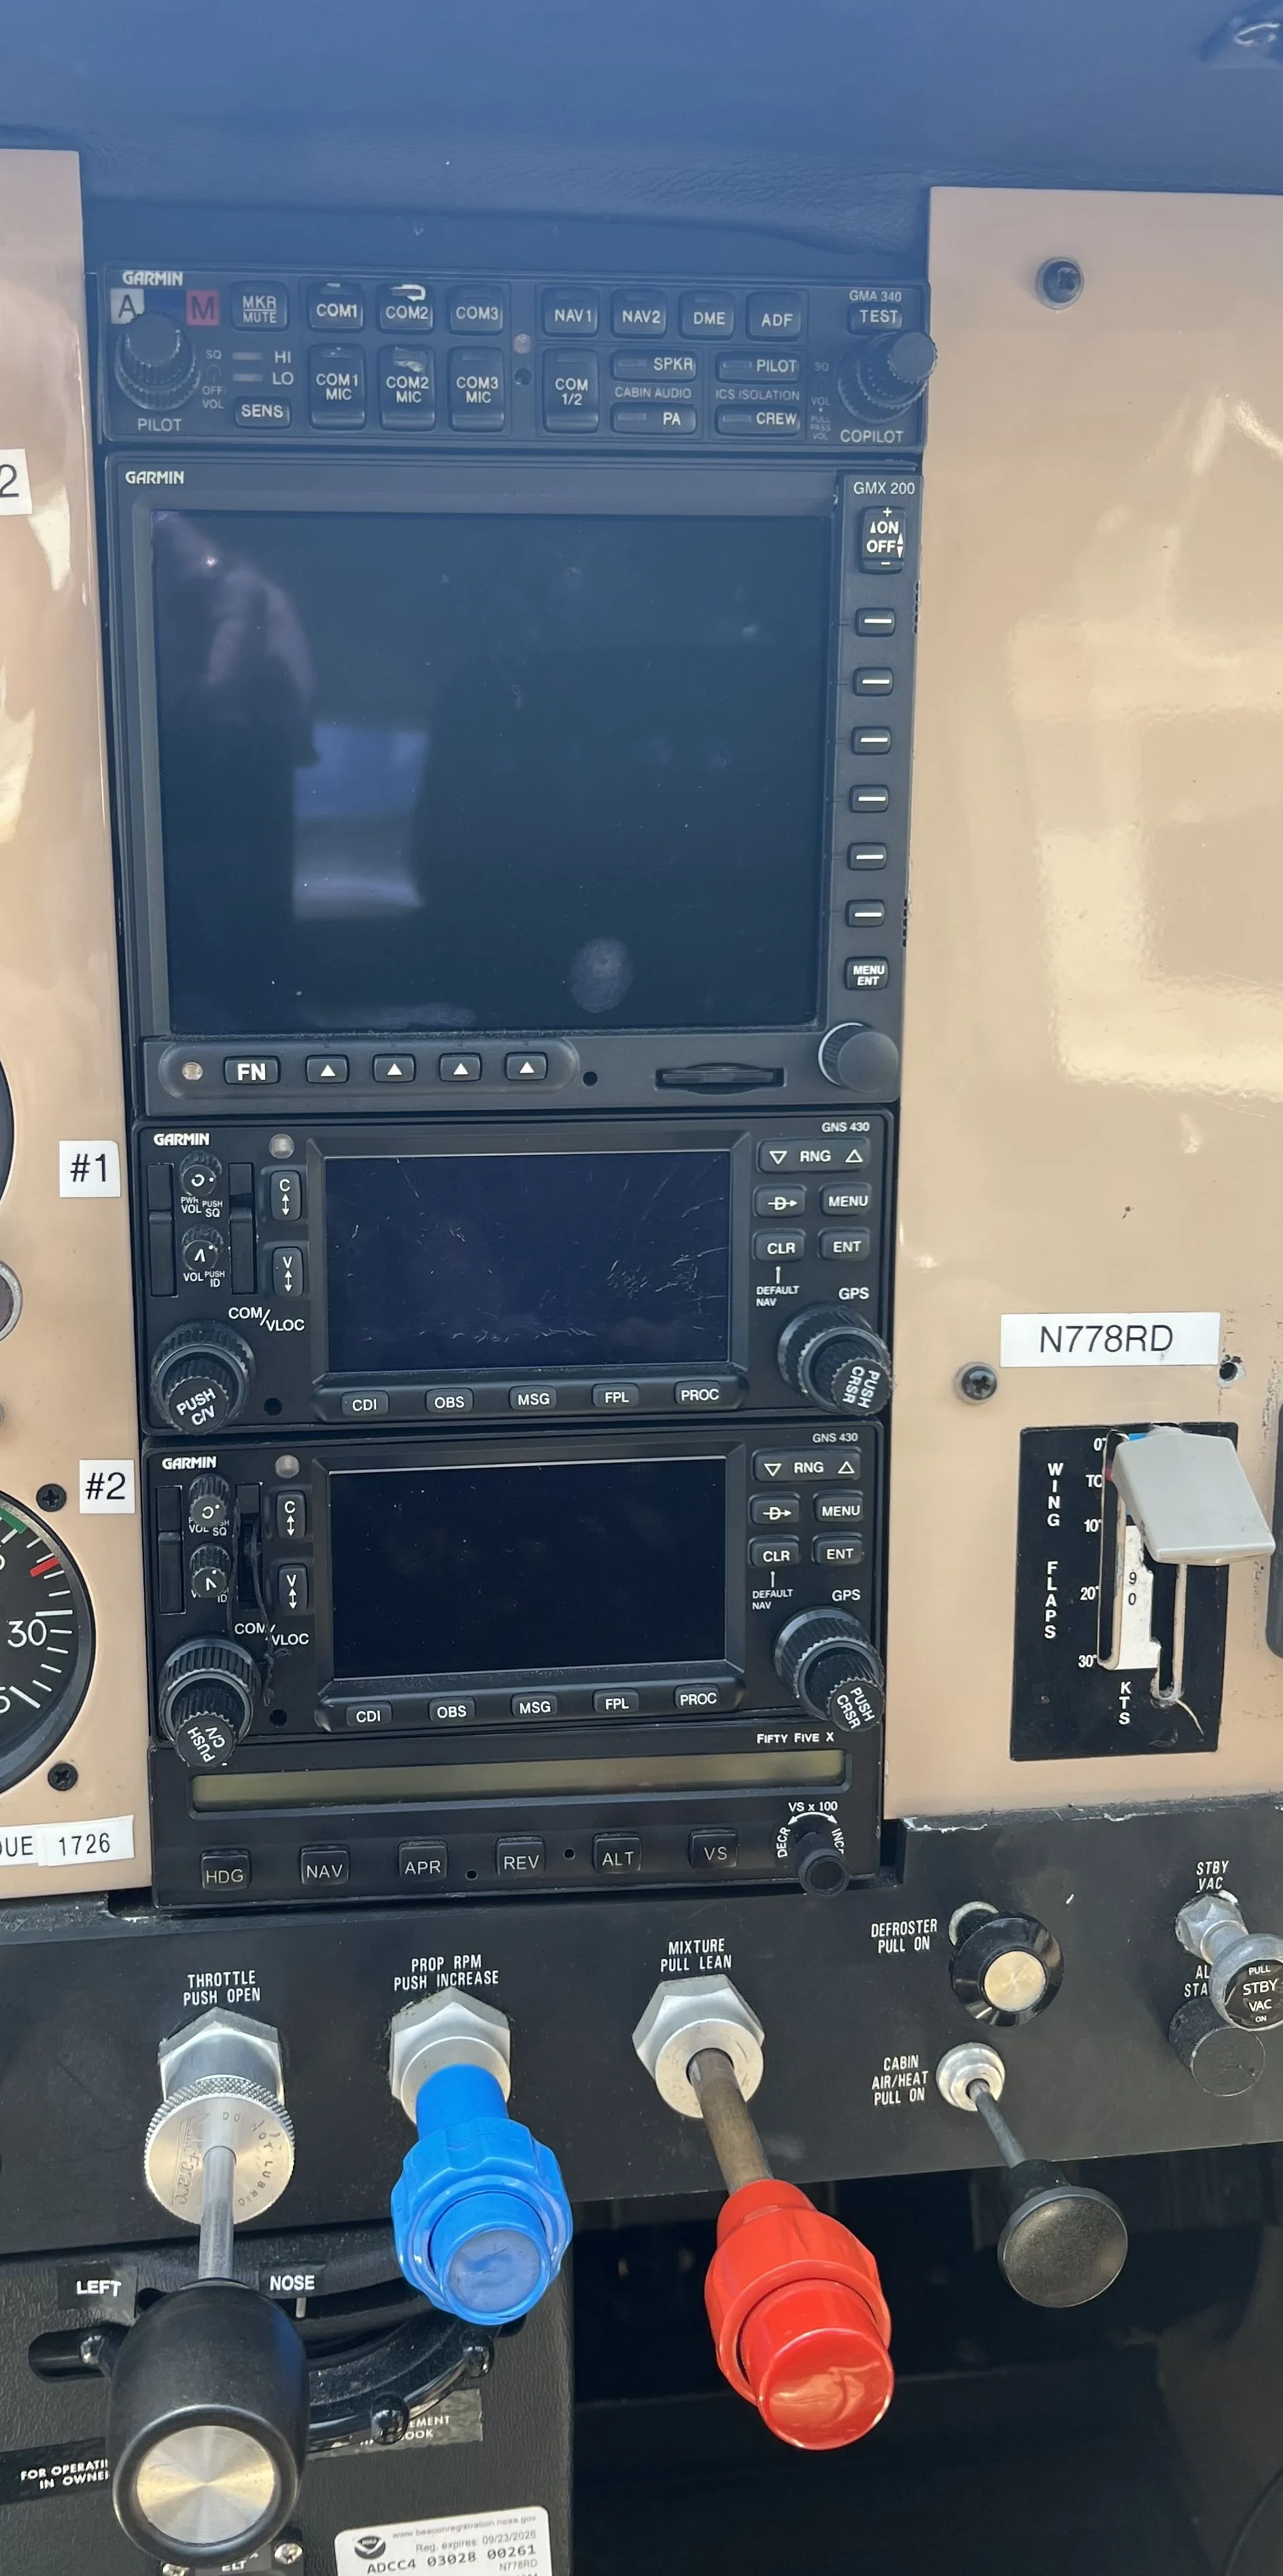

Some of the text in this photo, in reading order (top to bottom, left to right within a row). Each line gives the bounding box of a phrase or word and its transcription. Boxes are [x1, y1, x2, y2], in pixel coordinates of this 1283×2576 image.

[122, 271, 183, 286] GARMIN
[242, 296, 276, 309] MKR
[849, 290, 902, 302] GMA 340
[118, 295, 135, 318] A
[192, 296, 214, 319] M
[316, 304, 358, 318] COM1
[243, 311, 277, 324] MUTE
[386, 307, 428, 320] COM2
[456, 307, 499, 321] COM3
[555, 309, 592, 322] NAV1
[622, 311, 661, 324] NAV2
[694, 312, 725, 325] DME
[762, 313, 793, 327] ADF
[859, 310, 897, 324] TEST
[206, 349, 222, 360] SQ
[275, 351, 291, 364] HI
[653, 358, 693, 372] SPKR
[757, 360, 797, 373] PILOT
[273, 371, 294, 385] LO
[386, 377, 429, 390] COM2
[456, 377, 499, 390] COM3
[555, 378, 588, 391] COM
[202, 385, 223, 395] OFF
[326, 389, 352, 401] MIC
[615, 387, 692, 399] CABIN AUDIO
[715, 389, 800, 401] ICS ISOLATION
[202, 399, 224, 408] VOL
[396, 391, 422, 404] MIC
[466, 391, 492, 404] MIC
[562, 394, 582, 406] 1/2
[810, 396, 831, 406] VOL
[241, 404, 284, 418] SENS
[663, 412, 681, 425] PA
[756, 413, 798, 425] CREW
[137, 419, 182, 432] PILOT
[840, 430, 904, 443] COPILOT
[125, 470, 184, 485] GARMIN
[853, 481, 915, 495] GMX 200
[876, 521, 899, 534] ON
[866, 540, 896, 553] OFF
[853, 965, 885, 975] MENU
[857, 976, 880, 986] ENT
[237, 1064, 267, 1081] FN
[821, 1121, 870, 1132] GNS 430
[154, 1133, 210, 1146] GARMIN
[800, 1150, 832, 1162] RNG
[71, 1153, 107, 1182] #1
[202, 1200, 223, 1208] PUSH
[828, 1195, 869, 1207] MENU
[181, 1204, 220, 1218] VOL SQ
[767, 1242, 796, 1255] CLR
[833, 1241, 862, 1253] ENT
[183, 1270, 225, 1282] VOL PUSH
[210, 1278, 221, 1288] ID
[756, 1285, 800, 1295] DEFAULT
[838, 1287, 870, 1300] GPS
[756, 1298, 777, 1306] NAV
[1040, 1324, 1174, 1353] N778RD
[842, 1365, 866, 1404] CRSR
[517, 1393, 550, 1406] MSG
[604, 1391, 630, 1404] FPL
[681, 1388, 720, 1402] PROC
[176, 1388, 216, 1416] PUSH
[352, 1398, 377, 1412] CDI
[434, 1395, 465, 1409] OBS
[812, 1432, 859, 1443] GNS 430
[162, 1456, 217, 1469] GARMIN
[794, 1462, 824, 1474] RNG
[86, 1472, 126, 1500] #2
[1048, 1462, 1063, 1527] WING
[821, 1505, 861, 1516] MENU
[213, 1527, 227, 1536] SQ
[763, 1550, 791, 1562] CLR
[826, 1548, 855, 1560] ENT
[752, 1588, 794, 1599] DEFAULT
[832, 1588, 861, 1601] GPS
[1044, 1561, 1059, 1639] FLAPS
[752, 1601, 772, 1610] NAV
[7, 1618, 47, 1648] 30
[605, 1697, 630, 1710] FPL
[680, 1692, 717, 1706] PROC
[850, 1686, 876, 1722] PUSH
[1118, 1681, 1131, 1725] KTS
[437, 1705, 467, 1719] OBS
[519, 1701, 551, 1715] MSG
[836, 1694, 861, 1729] CRSR
[356, 1710, 381, 1723] CDI
[825, 1732, 835, 1742] X
[788, 1800, 838, 1812] VS 100
[58, 1832, 110, 1856] 1726
[776, 1826, 791, 1858] DECR
[602, 1851, 634, 1866] ALT
[704, 1846, 728, 1861] VS
[405, 1860, 441, 1875] APR
[503, 1855, 540, 1870] REV
[1196, 1860, 1229, 1876] STBY
[206, 1868, 244, 1883] HDG
[306, 1864, 343, 1879] NAV
[1199, 1877, 1224, 1890] VAC
[871, 1919, 938, 1938] DEFROSTER
[668, 1938, 725, 1955] MIXTURE
[878, 1935, 930, 1953] PULL ON
[411, 1954, 482, 1972] PROP RPM
[660, 1953, 732, 1972] PULL LEAN
[1248, 1965, 1271, 1976] PULL
[187, 1970, 256, 1989] THROTTLE
[394, 1970, 499, 1992] PUSH INCREASE
[1243, 1979, 1278, 1996] STBY
[183, 1986, 261, 2006] PUSH OPEN
[1248, 1999, 1272, 2012] VAC
[884, 2055, 919, 2072] CABIN
[872, 2070, 929, 2091] AIR/HEAT
[874, 2087, 925, 2106] PULL ON
[76, 2280, 122, 2298] LEFT
[269, 2275, 315, 2291] NOSE
[20, 2467, 47, 2481] FOR
[39, 2478, 55, 2490] IN
[415, 2529, 536, 2554] Reg. expires: 09/23/2026
[366, 2544, 536, 2575] ADCC4 03028 00261
[499, 2558, 538, 2573] N778RD
